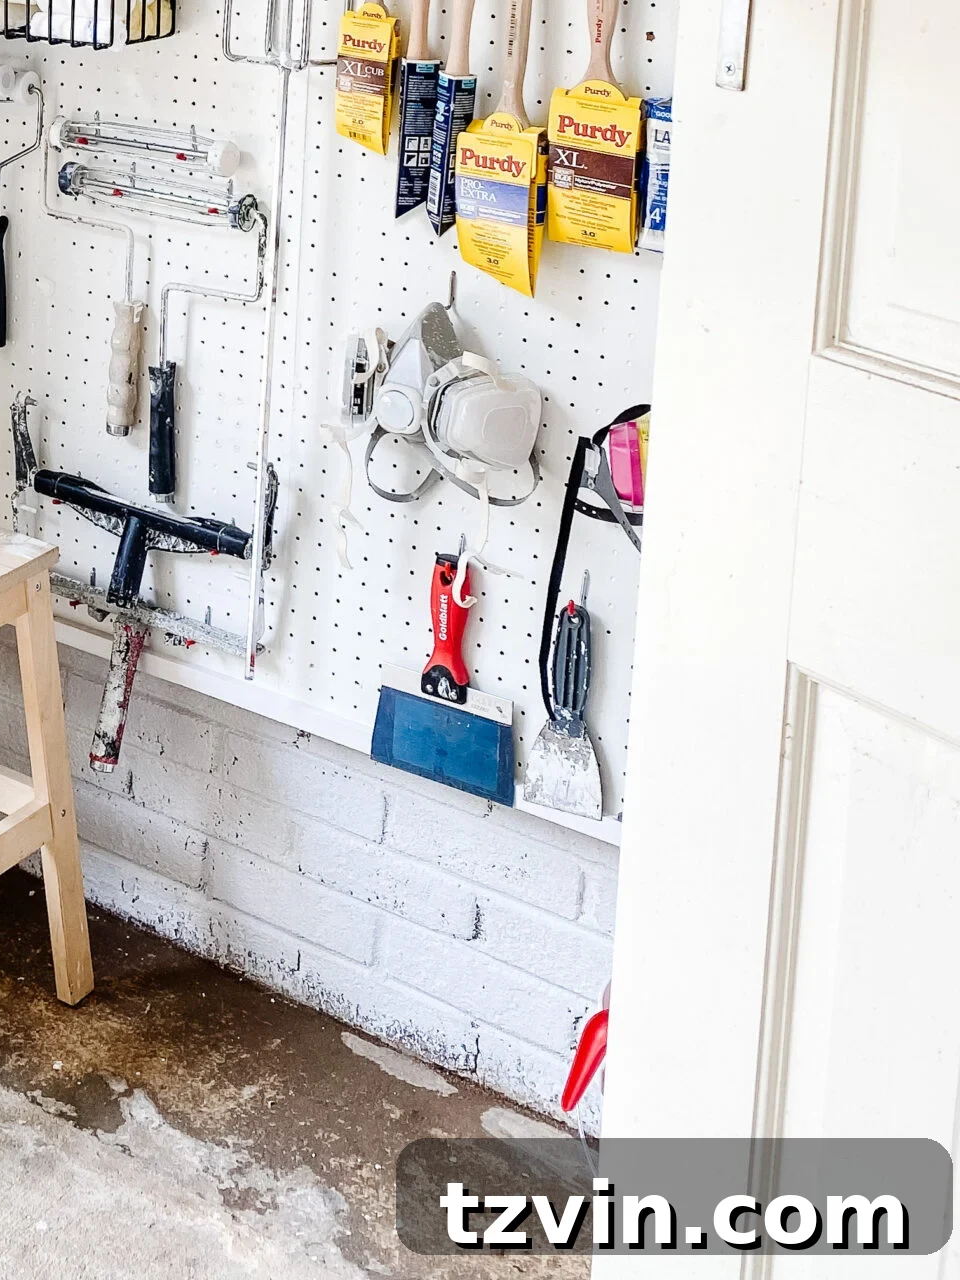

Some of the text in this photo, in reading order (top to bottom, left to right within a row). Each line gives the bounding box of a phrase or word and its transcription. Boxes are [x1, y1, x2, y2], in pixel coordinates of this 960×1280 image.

[362, 10, 382, 20] Purdy
[595, 18, 603, 43] Purdy
[342, 33, 386, 54] Purdy
[341, 59, 385, 78] XL CUB
[584, 86, 612, 98] Purdy
[490, 119, 513, 131] Purdy
[557, 114, 632, 148] Purdy
[460, 147, 527, 178] Purdy
[554, 147, 585, 169] XL
[460, 177, 484, 190] PRO-
[460, 186, 497, 203] EXTRA
[438, 593, 449, 641] Goldblatt
